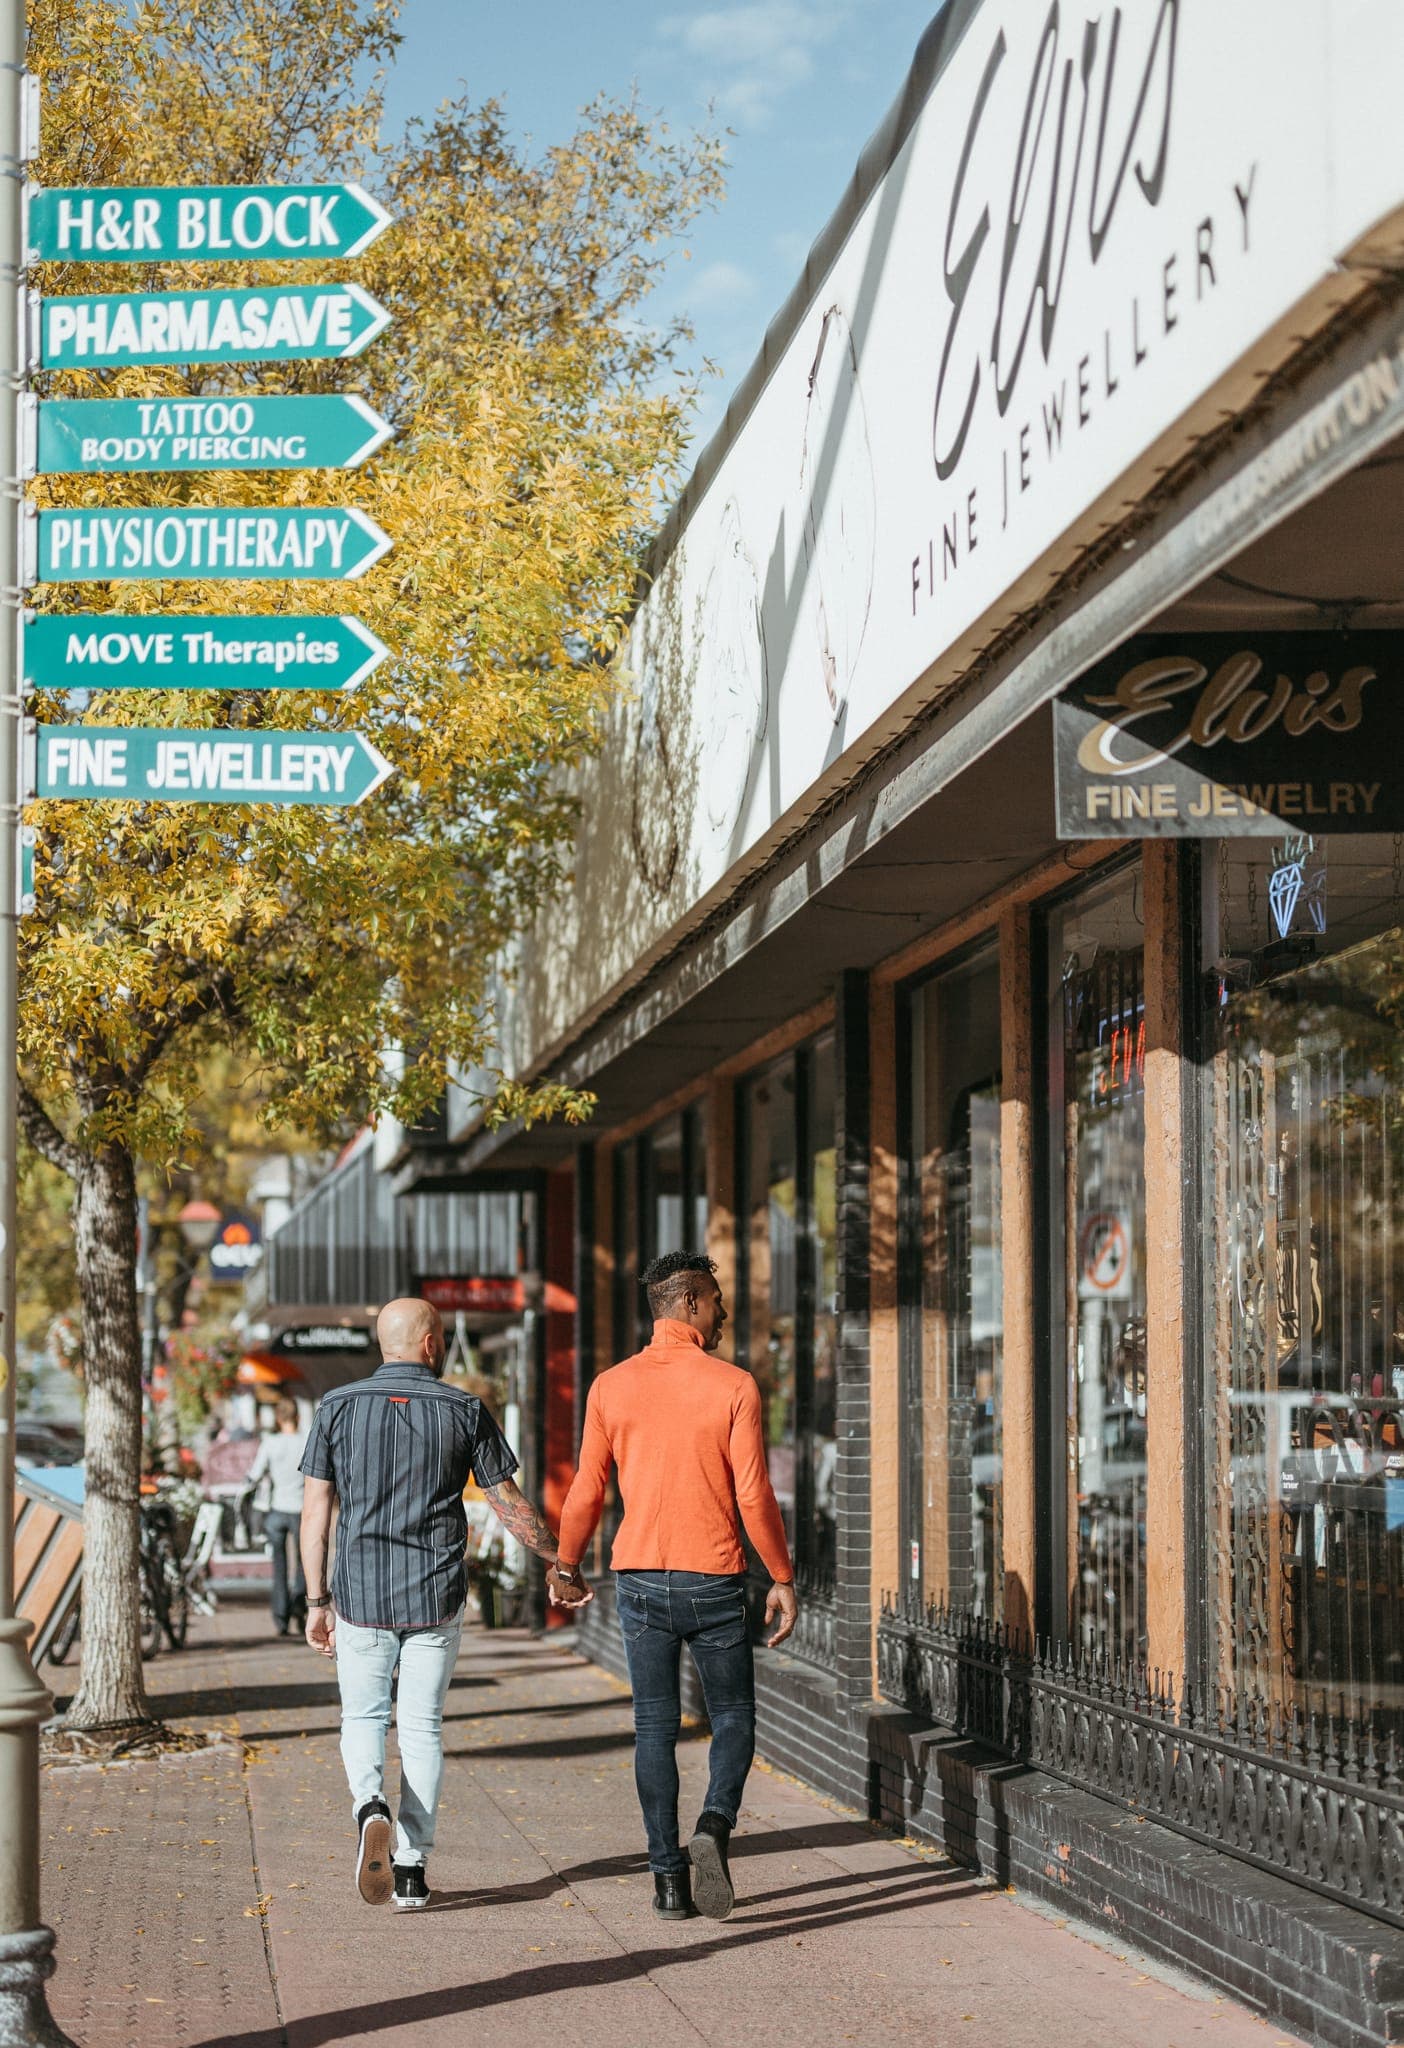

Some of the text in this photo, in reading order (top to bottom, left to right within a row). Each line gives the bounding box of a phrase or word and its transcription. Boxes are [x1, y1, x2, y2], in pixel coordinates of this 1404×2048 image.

[58, 195, 341, 251] H&R BLOCK
[48, 294, 353, 357] PHARMASAVE
[912, 487, 977, 616] FINE
[1003, 161, 1256, 530] JEWELLERY
[137, 402, 255, 435] TATTOO
[81, 435, 307, 463] BODY PIERCING
[50, 516, 351, 569] PHYSIOTHERAPY
[65, 631, 340, 674] MOVE Therapies
[1076, 649, 1378, 776] Elvis
[47, 737, 355, 793] FINE JEWELLERY
[1085, 782, 1382, 819] FINE JEWELRY
